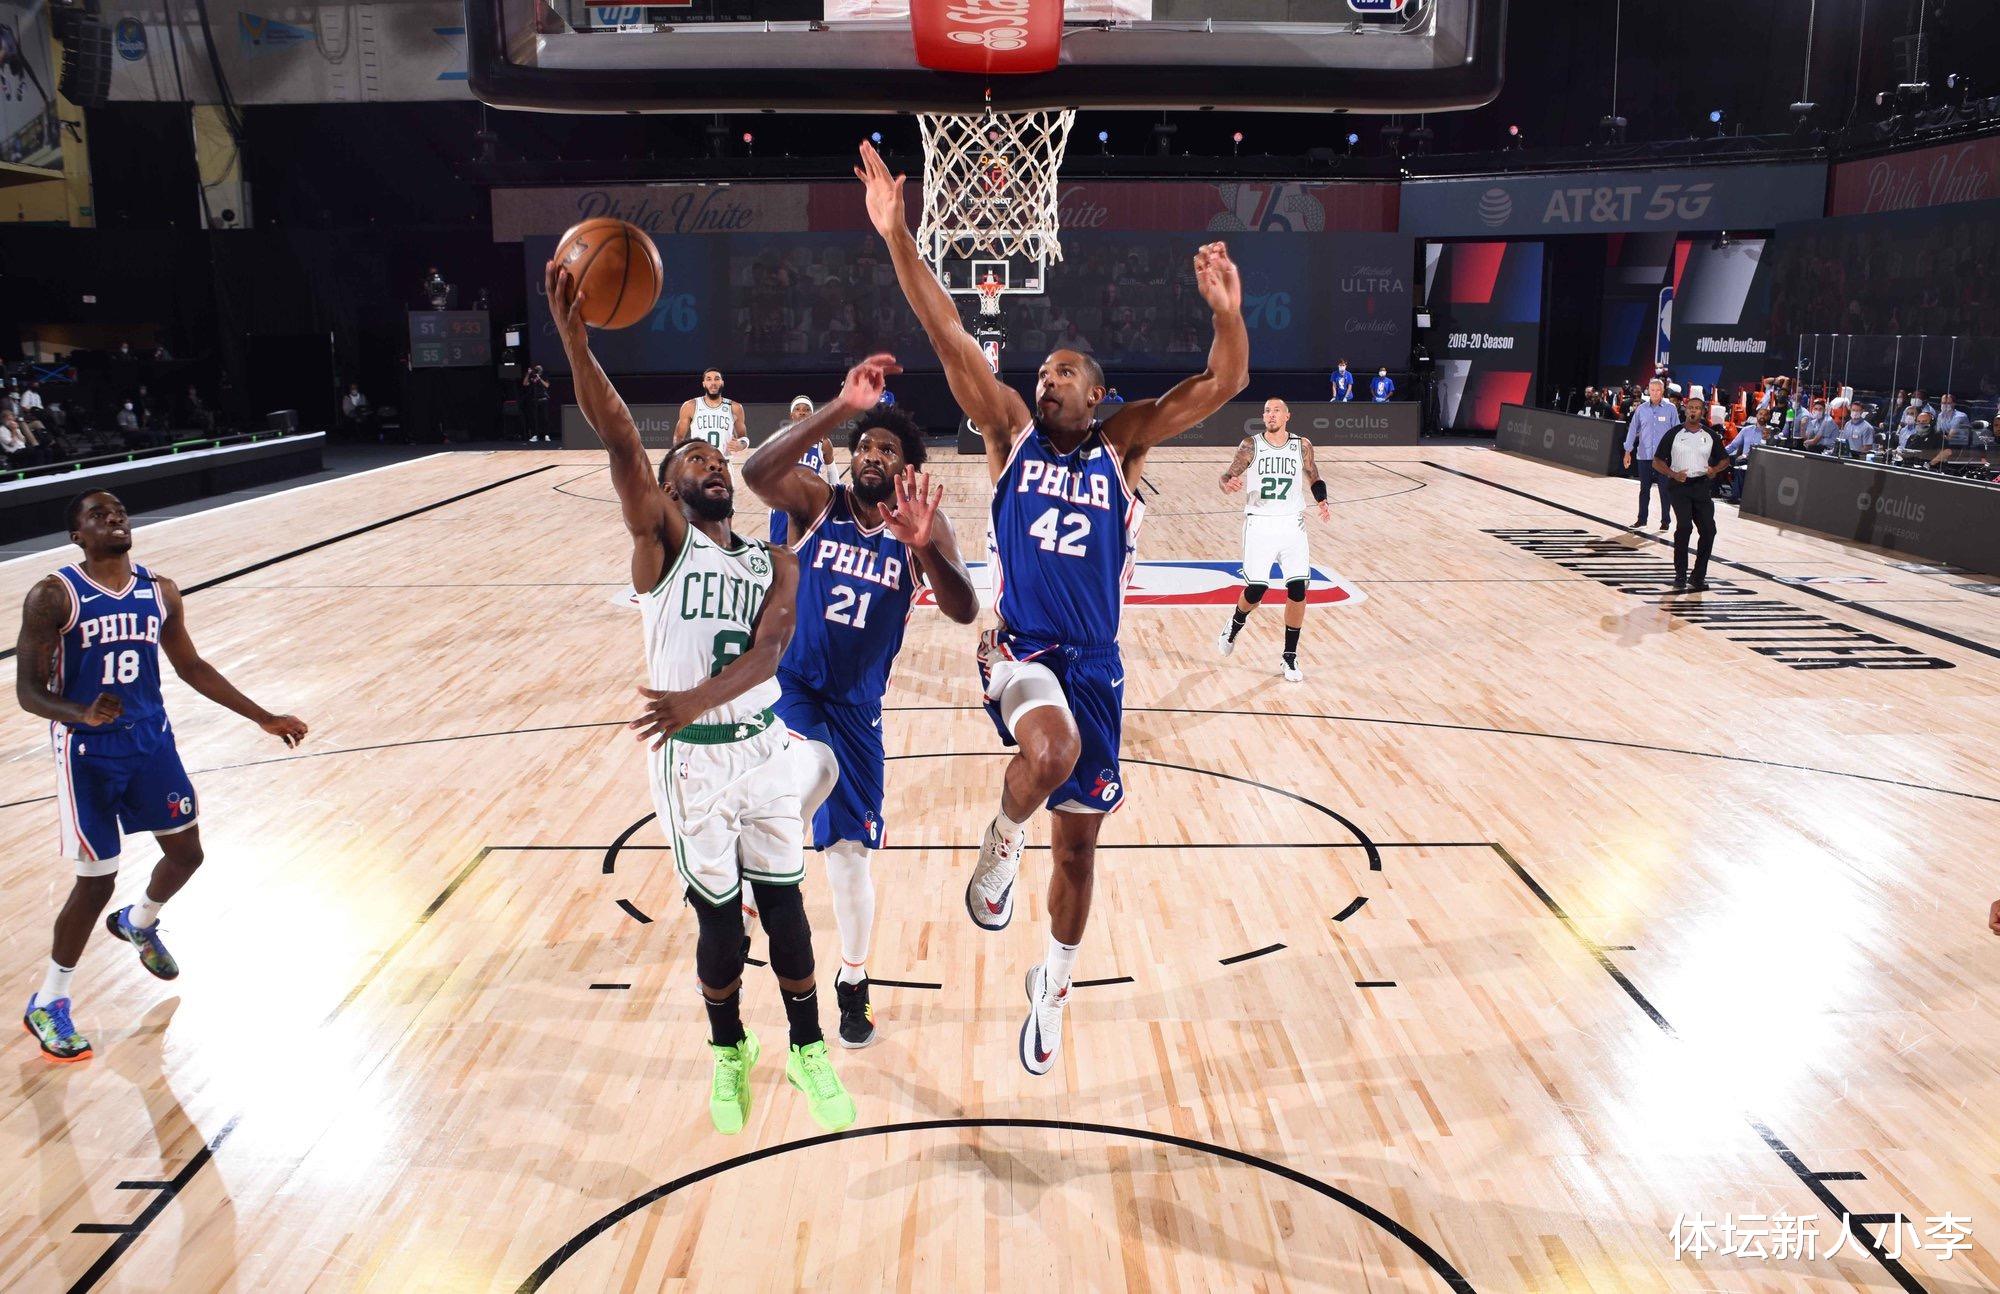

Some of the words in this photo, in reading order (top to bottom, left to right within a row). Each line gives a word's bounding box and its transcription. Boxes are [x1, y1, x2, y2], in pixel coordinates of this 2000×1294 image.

[671, 187, 752, 233] Unite
[1542, 187, 1641, 223] AT&T
[1644, 183, 1716, 221] 5G
[1341, 279, 1404, 293] ULTRA
[1245, 291, 1291, 330] 76
[421, 322, 435, 335] 51
[1447, 333, 1481, 349] 2019-20
[1482, 334, 1514, 350] Season
[1696, 338, 1767, 353] #WholeNewGam
[423, 349, 439, 361] 55
[454, 347, 462, 360] 3
[697, 414, 730, 431] CELTICS
[1335, 415, 1389, 429] oculus
[708, 431, 719, 448] 0
[1258, 457, 1297, 477] CELTICS
[1018, 459, 1110, 510] PHILA
[1260, 477, 1293, 500] 27
[1876, 495, 1926, 523] oculus
[1028, 508, 1092, 558] 42
[812, 540, 902, 590] PHILA
[825, 585, 873, 629] 21
[79, 613, 162, 649] PHILA
[102, 649, 140, 685] 18
[1089, 778, 1120, 802] 76
[167, 796, 192, 818] 76
